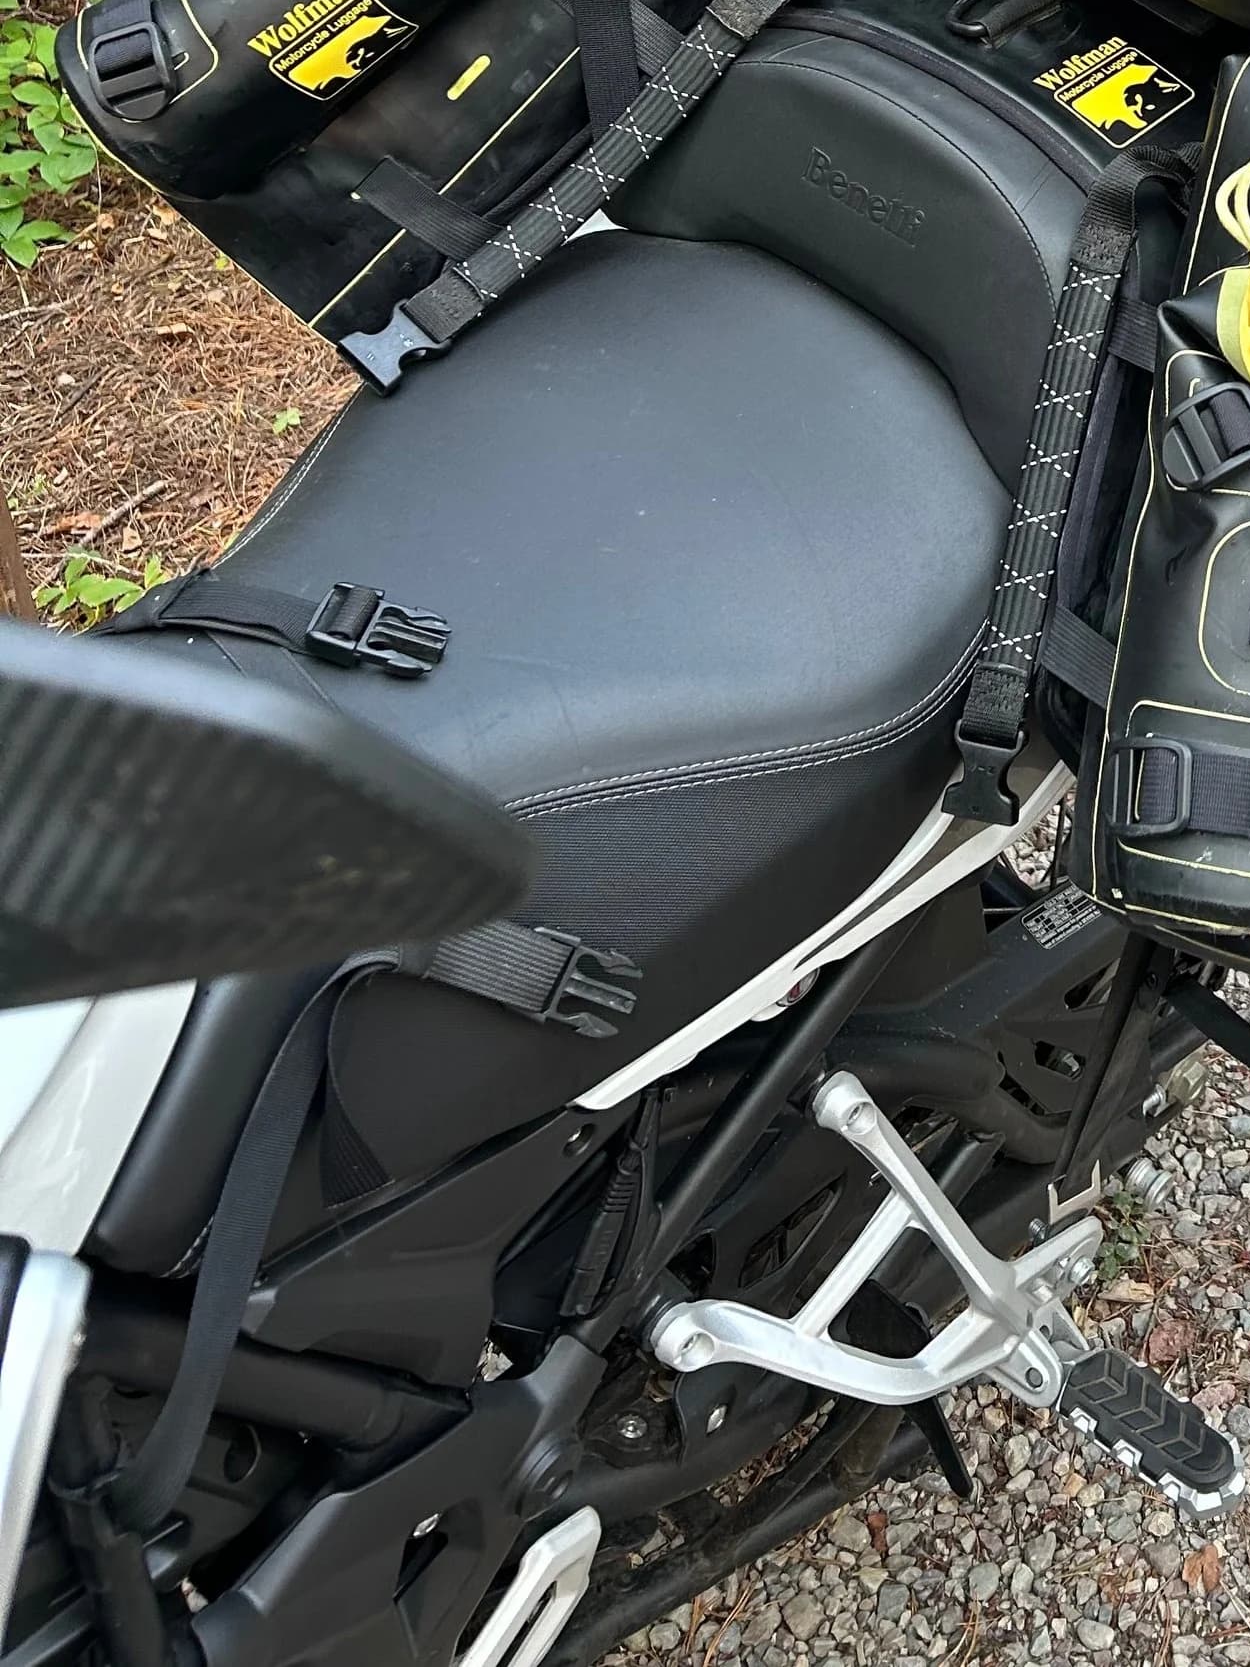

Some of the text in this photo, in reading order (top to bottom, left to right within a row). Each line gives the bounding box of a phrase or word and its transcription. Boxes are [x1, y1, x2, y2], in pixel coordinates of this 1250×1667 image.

[274, 28, 330, 72] Motorcycle
[1032, 36, 1129, 91] Wolfman
[1058, 50, 1139, 103] Motorcycle Luggage
